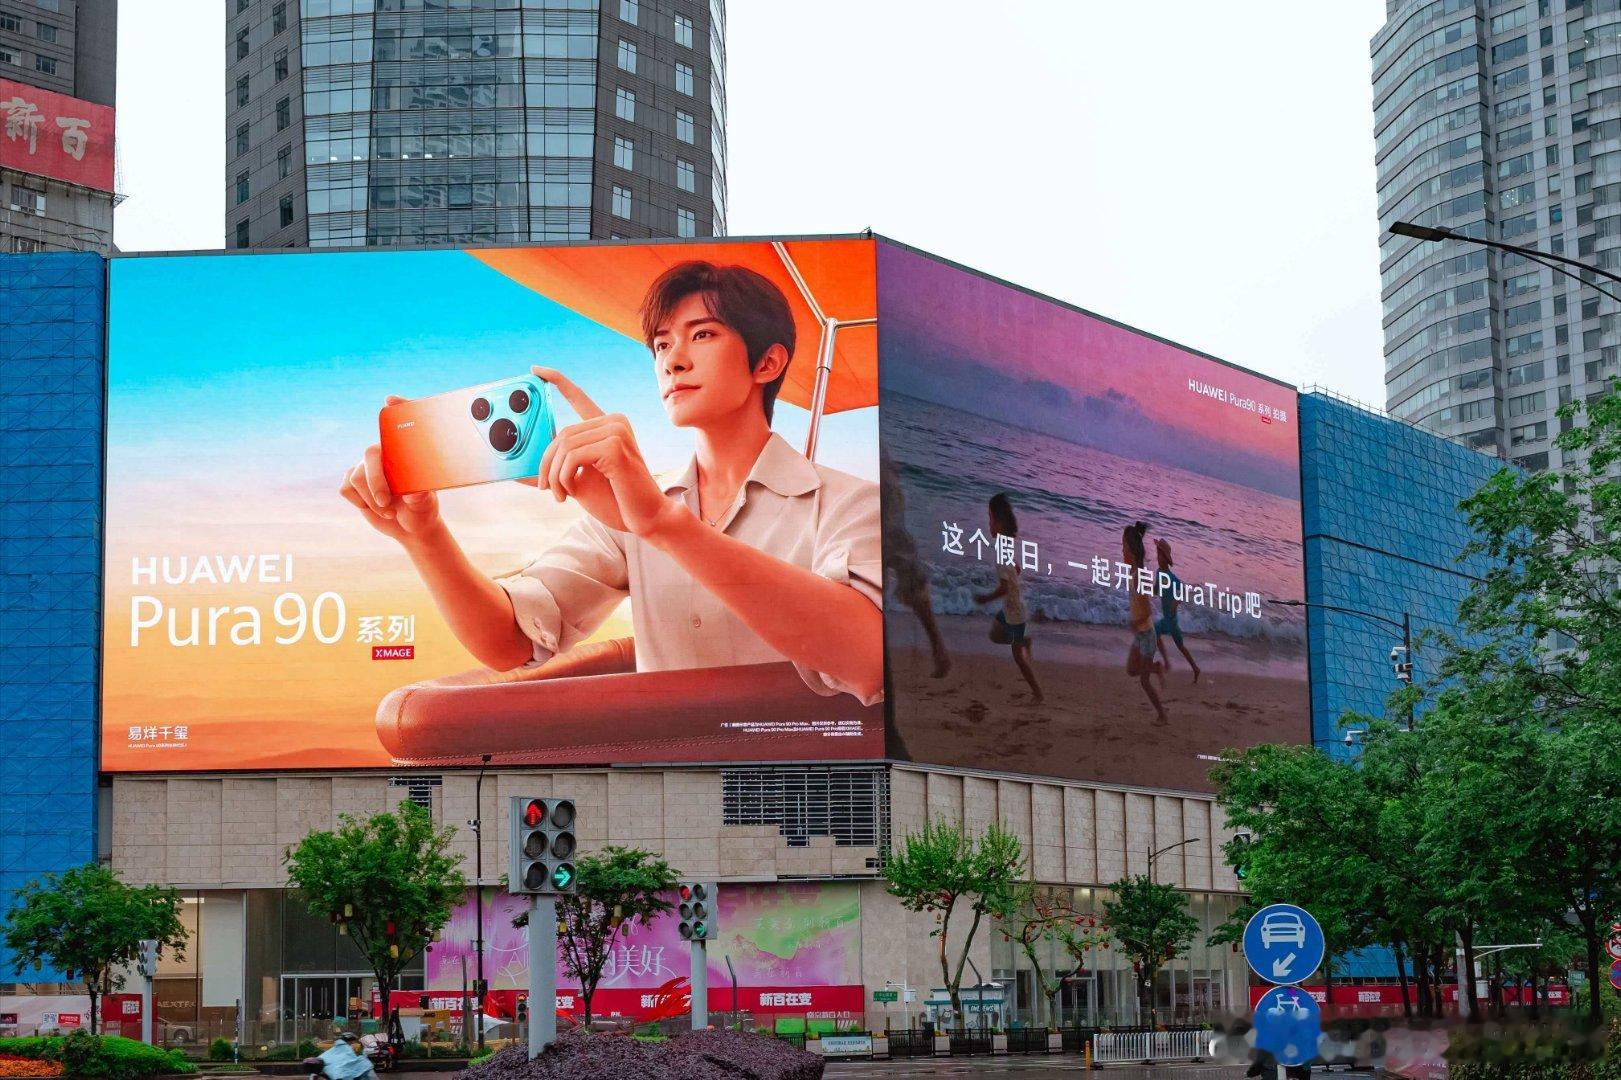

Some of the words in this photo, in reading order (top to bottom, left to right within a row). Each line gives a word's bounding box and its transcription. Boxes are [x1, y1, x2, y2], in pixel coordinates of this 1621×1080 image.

[0, 97, 91, 161] 新百
[1188, 378, 1227, 402] HUAWEI
[131, 553, 294, 585] HUAWEI
[356, 614, 415, 643] 系列
[375, 648, 411, 657] XMAGE
[127, 725, 189, 741] 易烊千玺
[760, 992, 812, 1007] 新百在变
